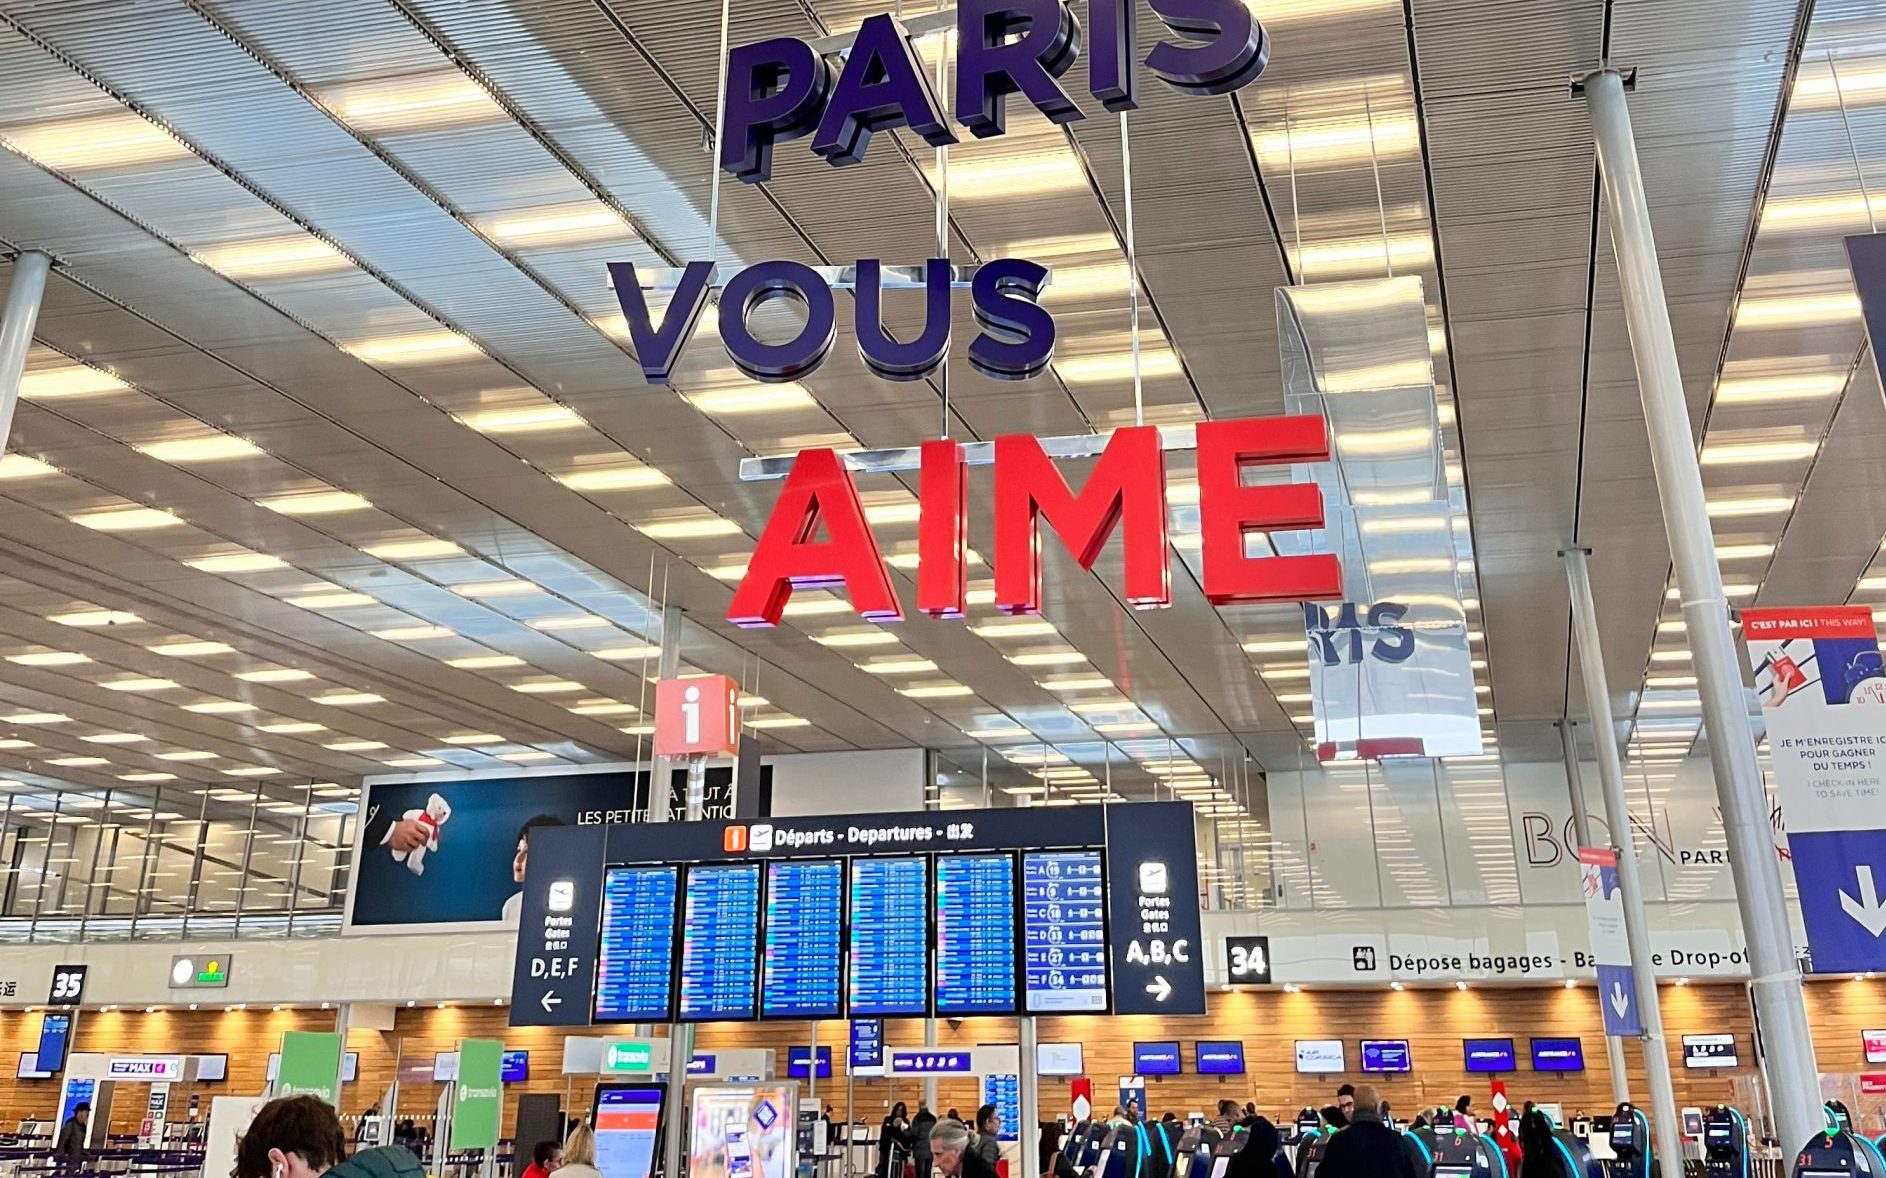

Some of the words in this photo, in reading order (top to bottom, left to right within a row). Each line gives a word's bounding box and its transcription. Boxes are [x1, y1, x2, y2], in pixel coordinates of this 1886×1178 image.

[720, 0, 1271, 183] PARIS
[606, 258, 1057, 384] VOUS
[727, 414, 1344, 629] AIME
[1751, 620, 1776, 630] C'EST
[1779, 619, 1798, 629] PAR
[1800, 619, 1813, 628] ICI
[1820, 618, 1841, 627] THIS
[1857, 696, 1866, 704] 10
[1780, 739, 1793, 748] JE
[1795, 736, 1874, 747] M'ENREGISTRE
[1800, 750, 1830, 759] POUR
[1832, 748, 1876, 758] GAGNER
[1813, 763, 1829, 771] DU
[1832, 761, 1866, 771] TEMPS
[1858, 778, 1881, 786] HERE
[1816, 790, 1828, 799] TO
[1830, 789, 1853, 798] SAVE
[577, 811, 602, 826] LES
[775, 828, 835, 848] Départs
[847, 826, 933, 846] Departures
[1138, 895, 1170, 907] Portes
[1140, 908, 1170, 920] Gates
[544, 916, 573, 927] Portes
[544, 928, 570, 939] Gates
[1126, 939, 1189, 966] A,B,C
[1230, 946, 1266, 975] 34
[1390, 953, 1461, 975] Dépose
[1469, 952, 1553, 974] bagages
[531, 957, 579, 980] D,E,F
[52, 972, 83, 998] 35
[1798, 1153, 1812, 1166] 31
